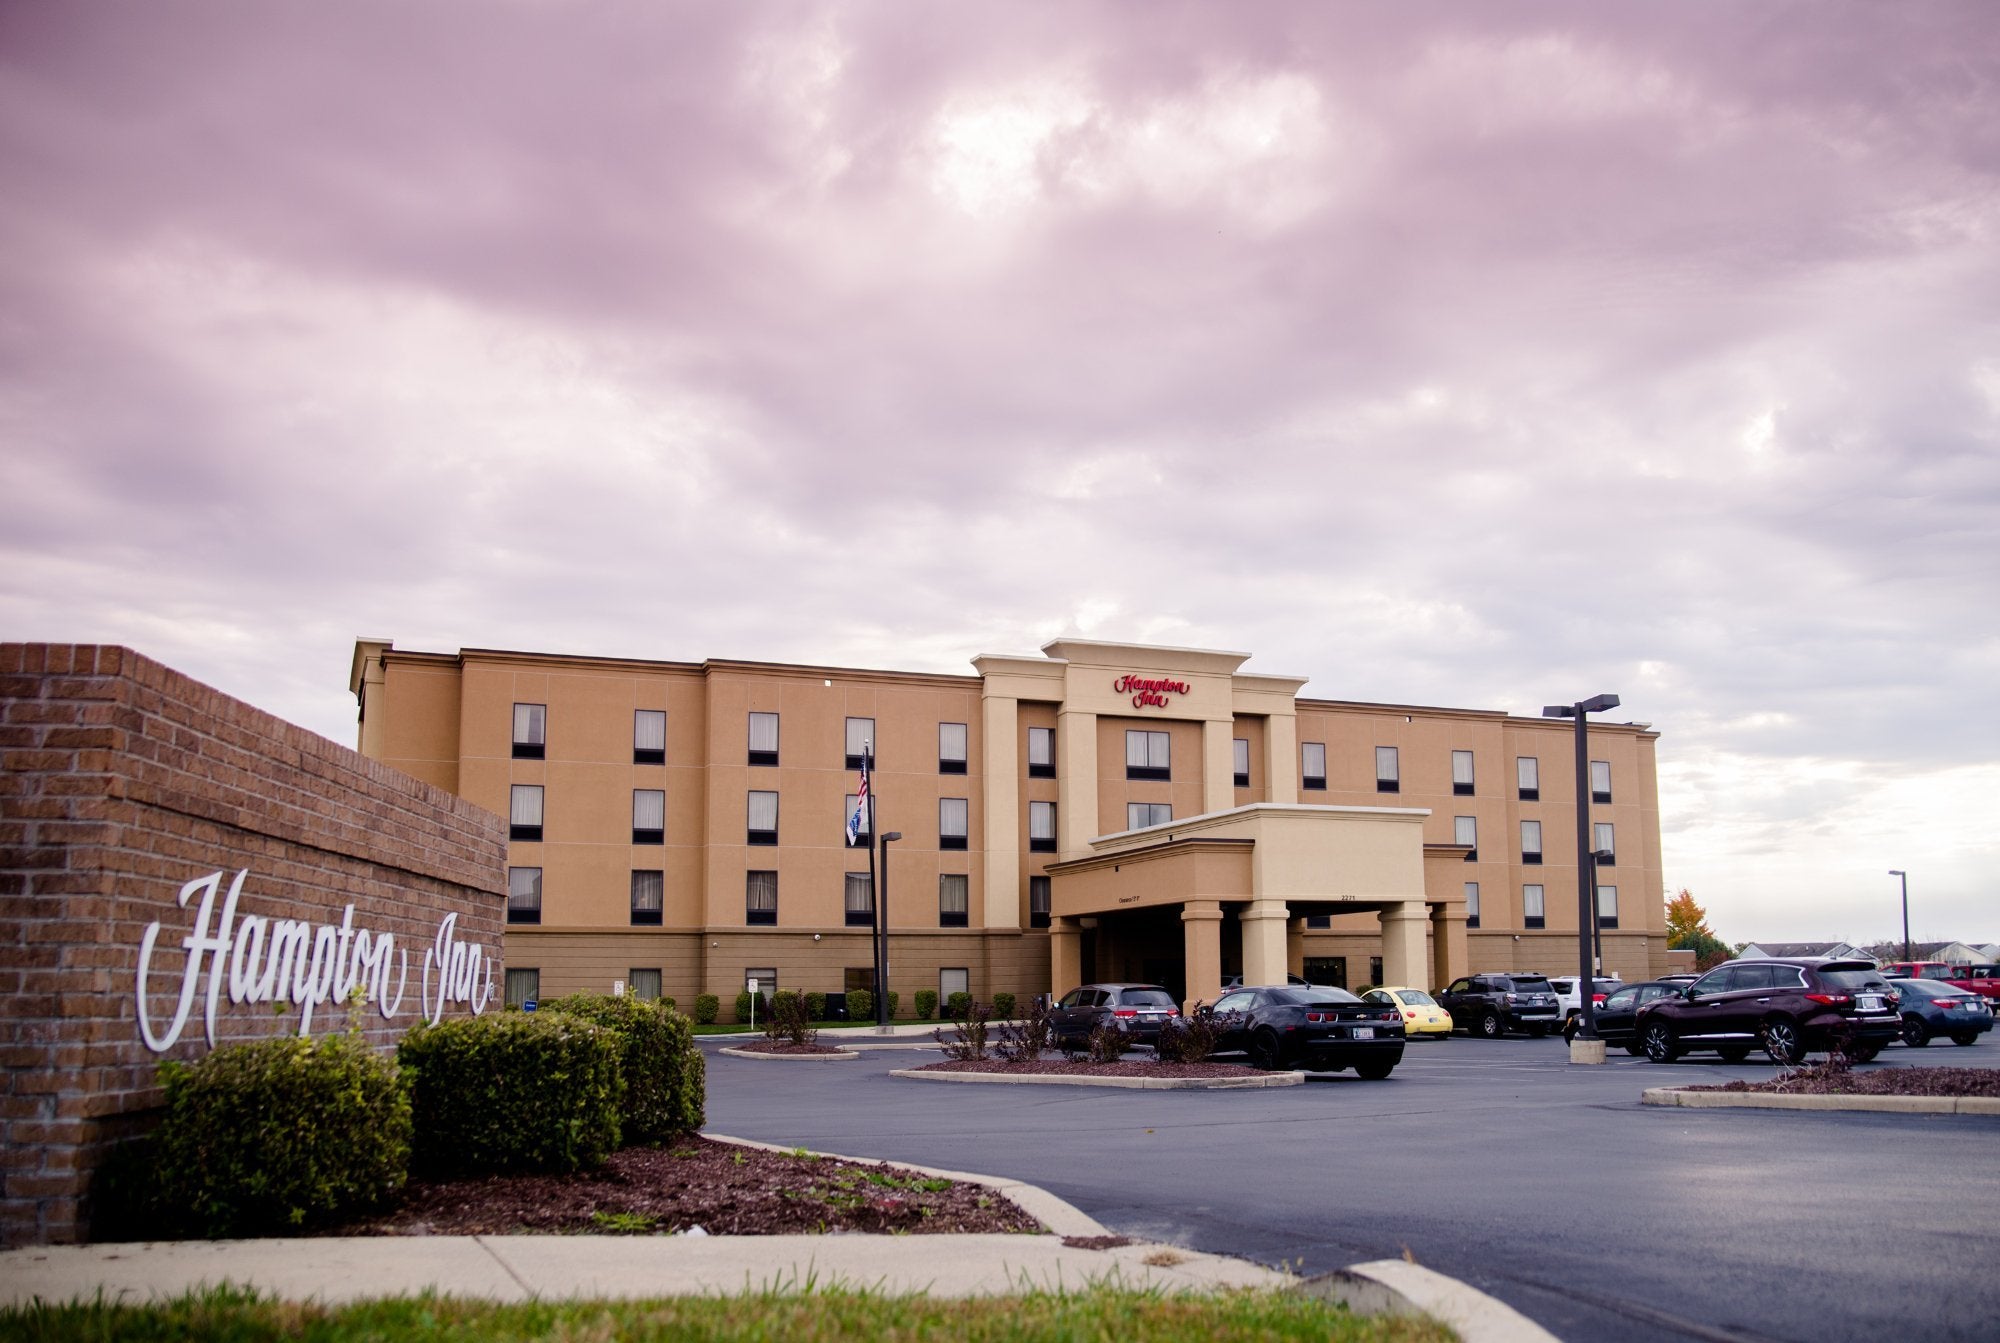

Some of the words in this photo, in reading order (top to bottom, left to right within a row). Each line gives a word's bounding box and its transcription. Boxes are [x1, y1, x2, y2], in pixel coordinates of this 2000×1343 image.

[1114, 674, 1190, 695] Hampton
[1133, 690, 1168, 709] Inn
[137, 868, 407, 1052] Hampton
[422, 912, 491, 1029] Inn
